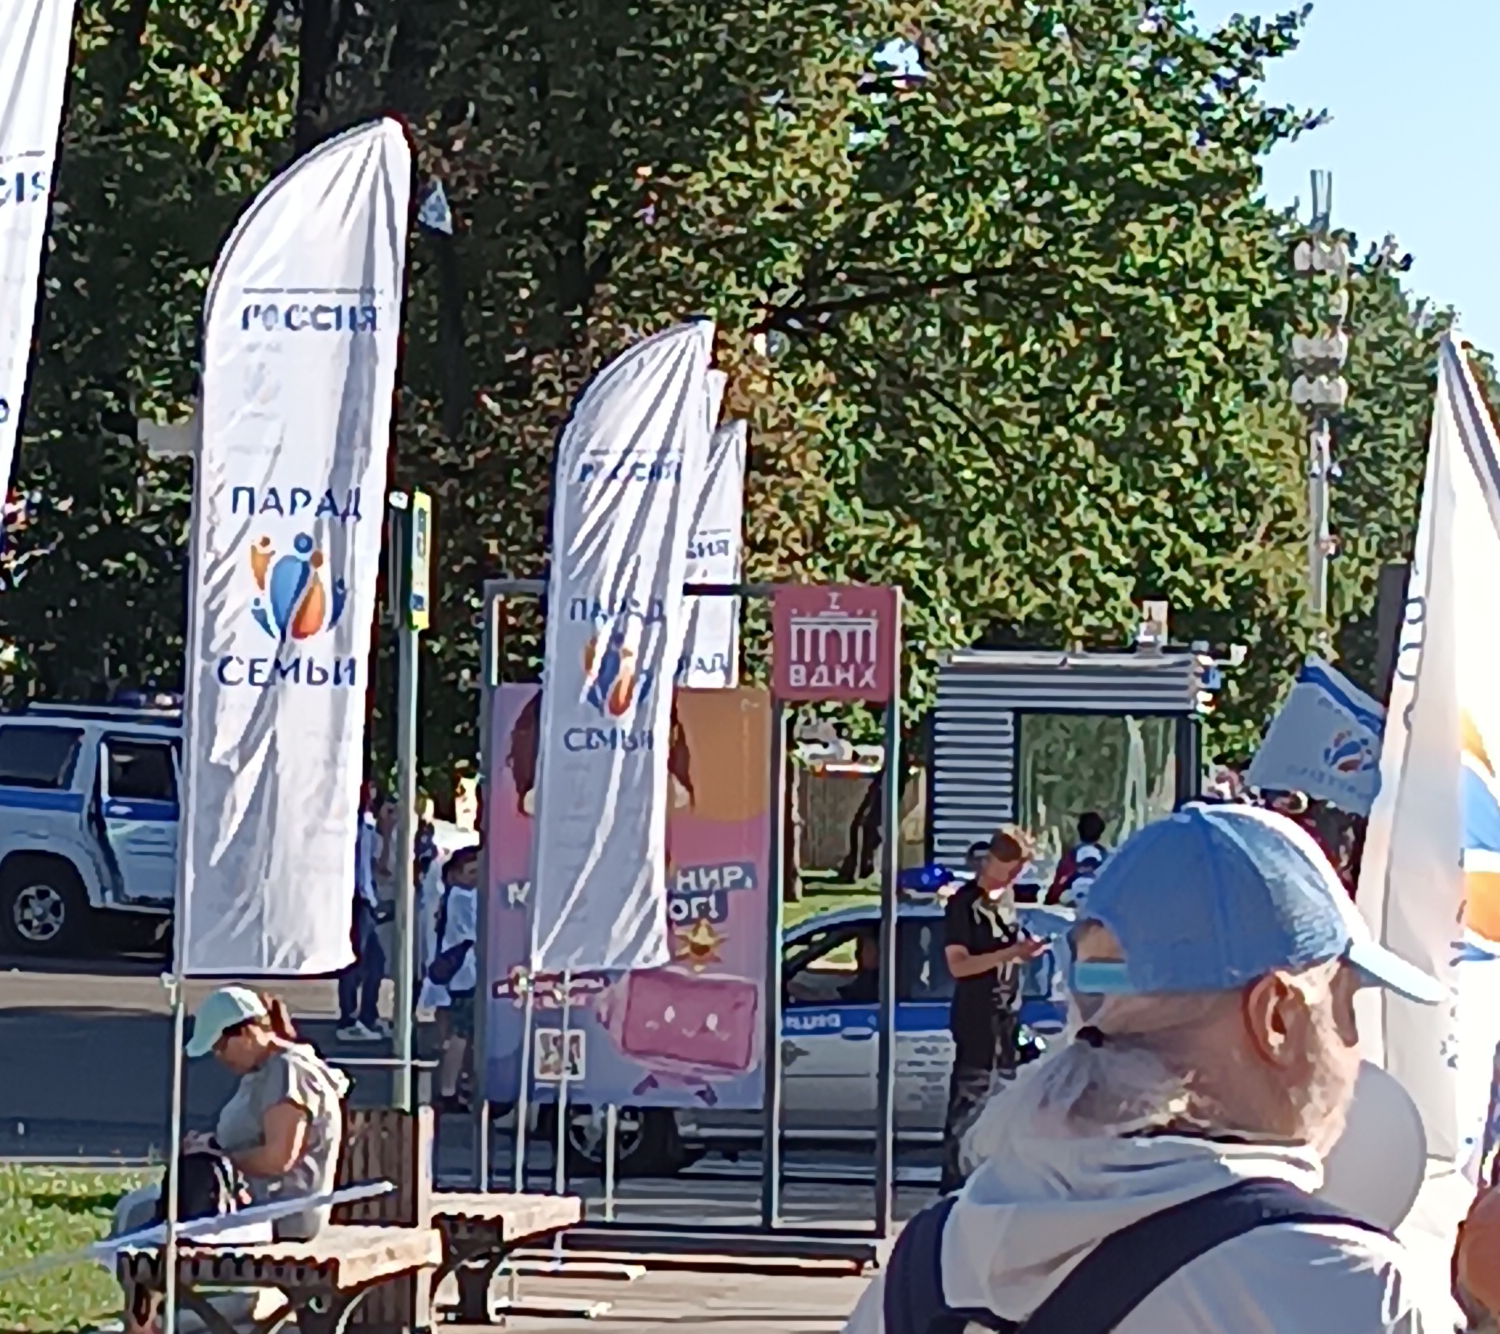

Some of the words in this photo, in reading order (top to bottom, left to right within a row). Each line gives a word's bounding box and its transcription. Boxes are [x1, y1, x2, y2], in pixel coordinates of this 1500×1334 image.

[241, 304, 378, 332] РОССИЯ
[231, 486, 363, 525] ПАРАД
[217, 656, 357, 687] СЕМЬИ
[789, 663, 877, 688] ВДНХ
[563, 727, 654, 753] СЕМЬИ
